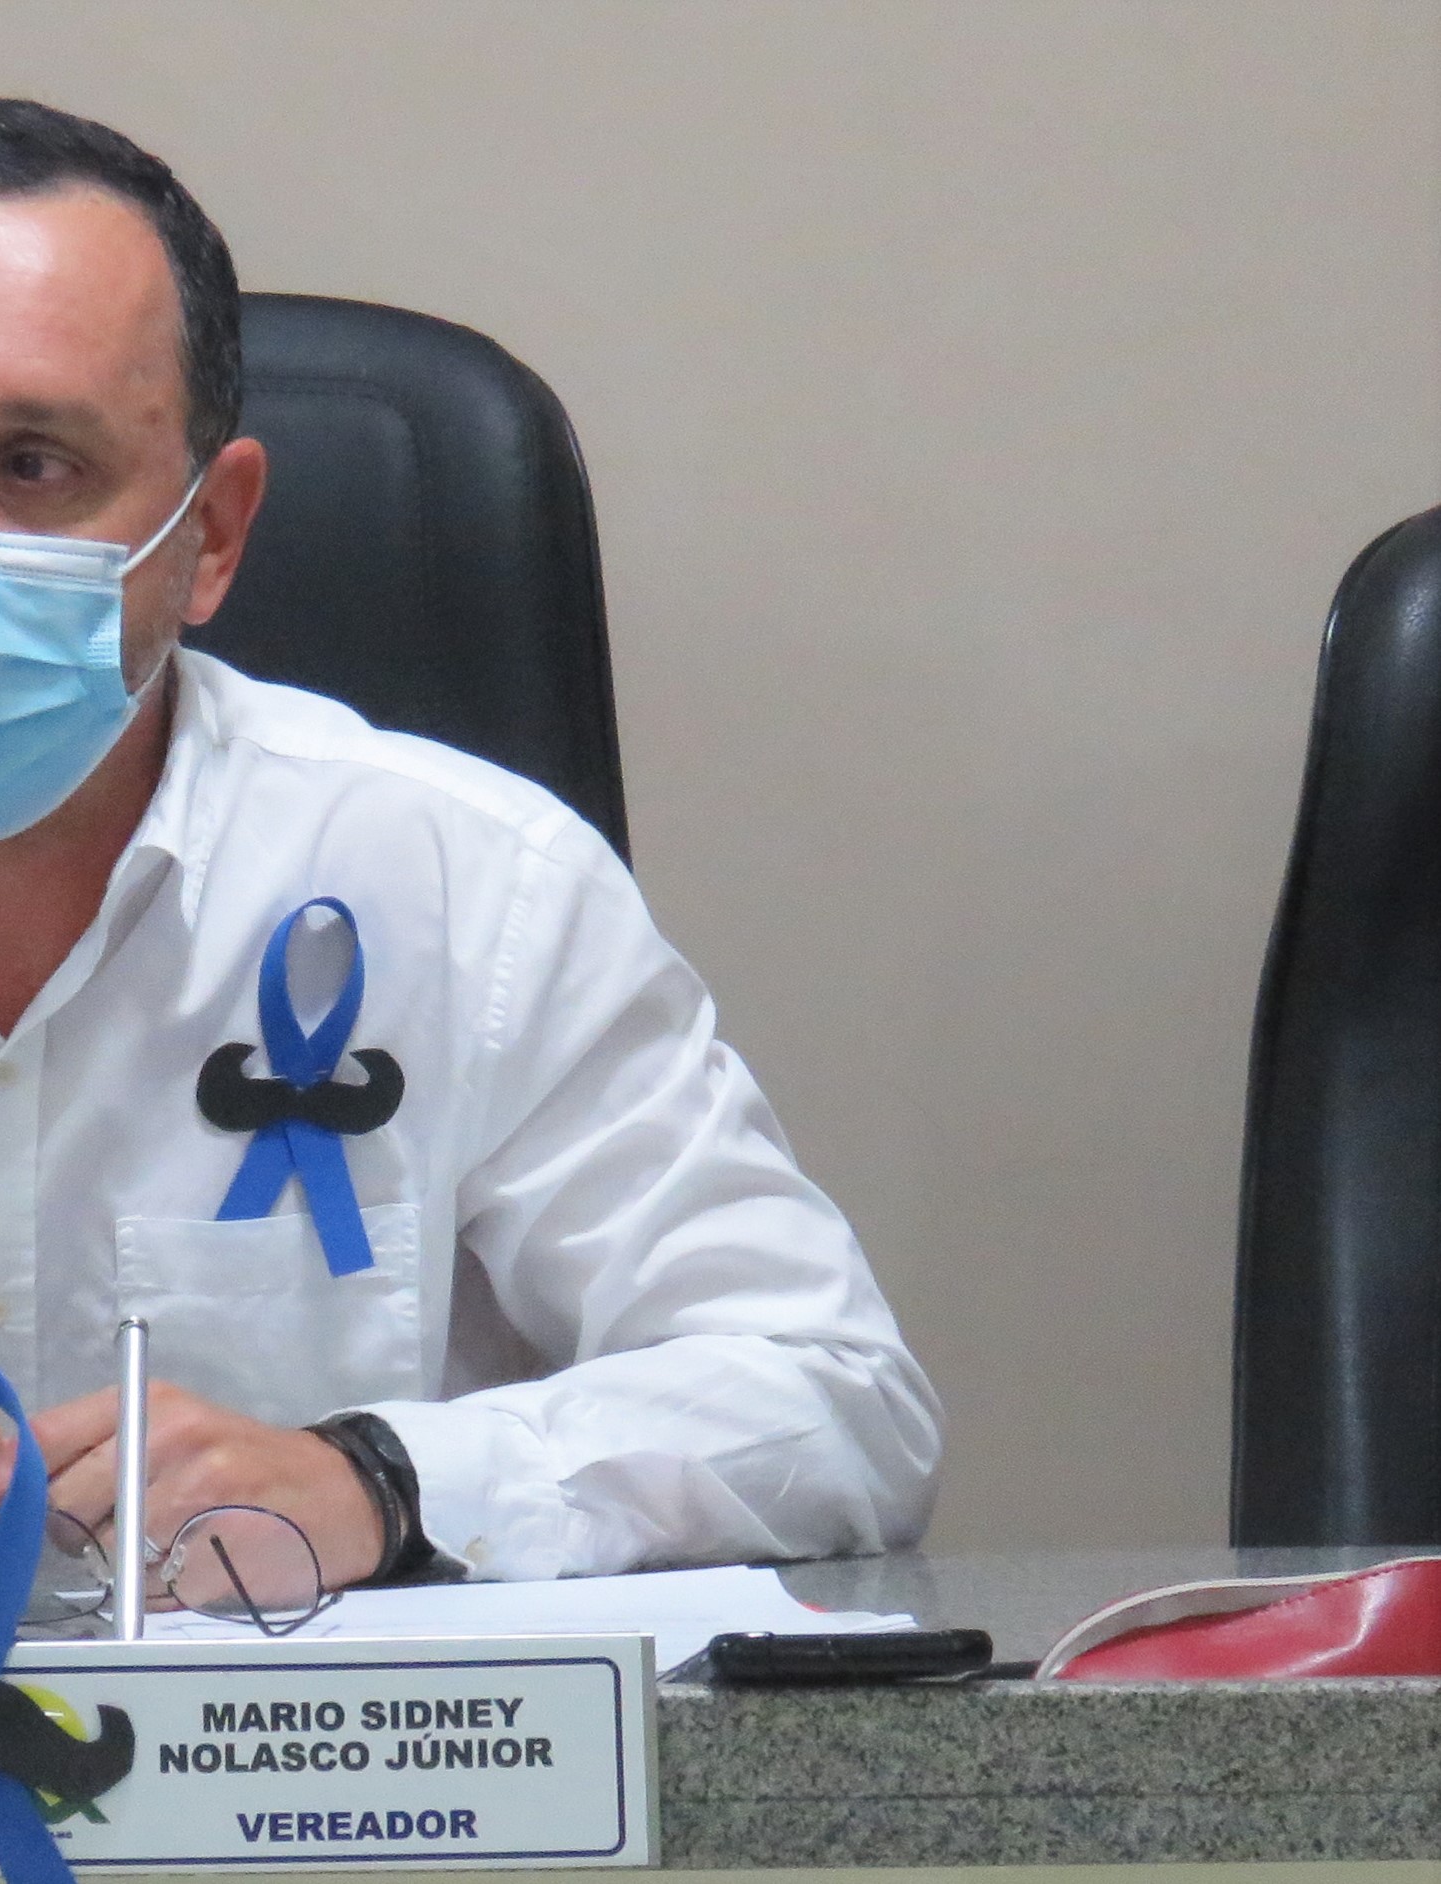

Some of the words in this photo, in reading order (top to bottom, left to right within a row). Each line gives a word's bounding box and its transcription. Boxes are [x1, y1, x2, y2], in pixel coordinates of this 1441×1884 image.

[201, 1700, 347, 1734] MARIO
[359, 1697, 525, 1732] SIDNEY
[158, 1740, 371, 1775] NOLASCO
[383, 1731, 554, 1772] JÚNIOR
[235, 1808, 480, 1844] VEREADOR
